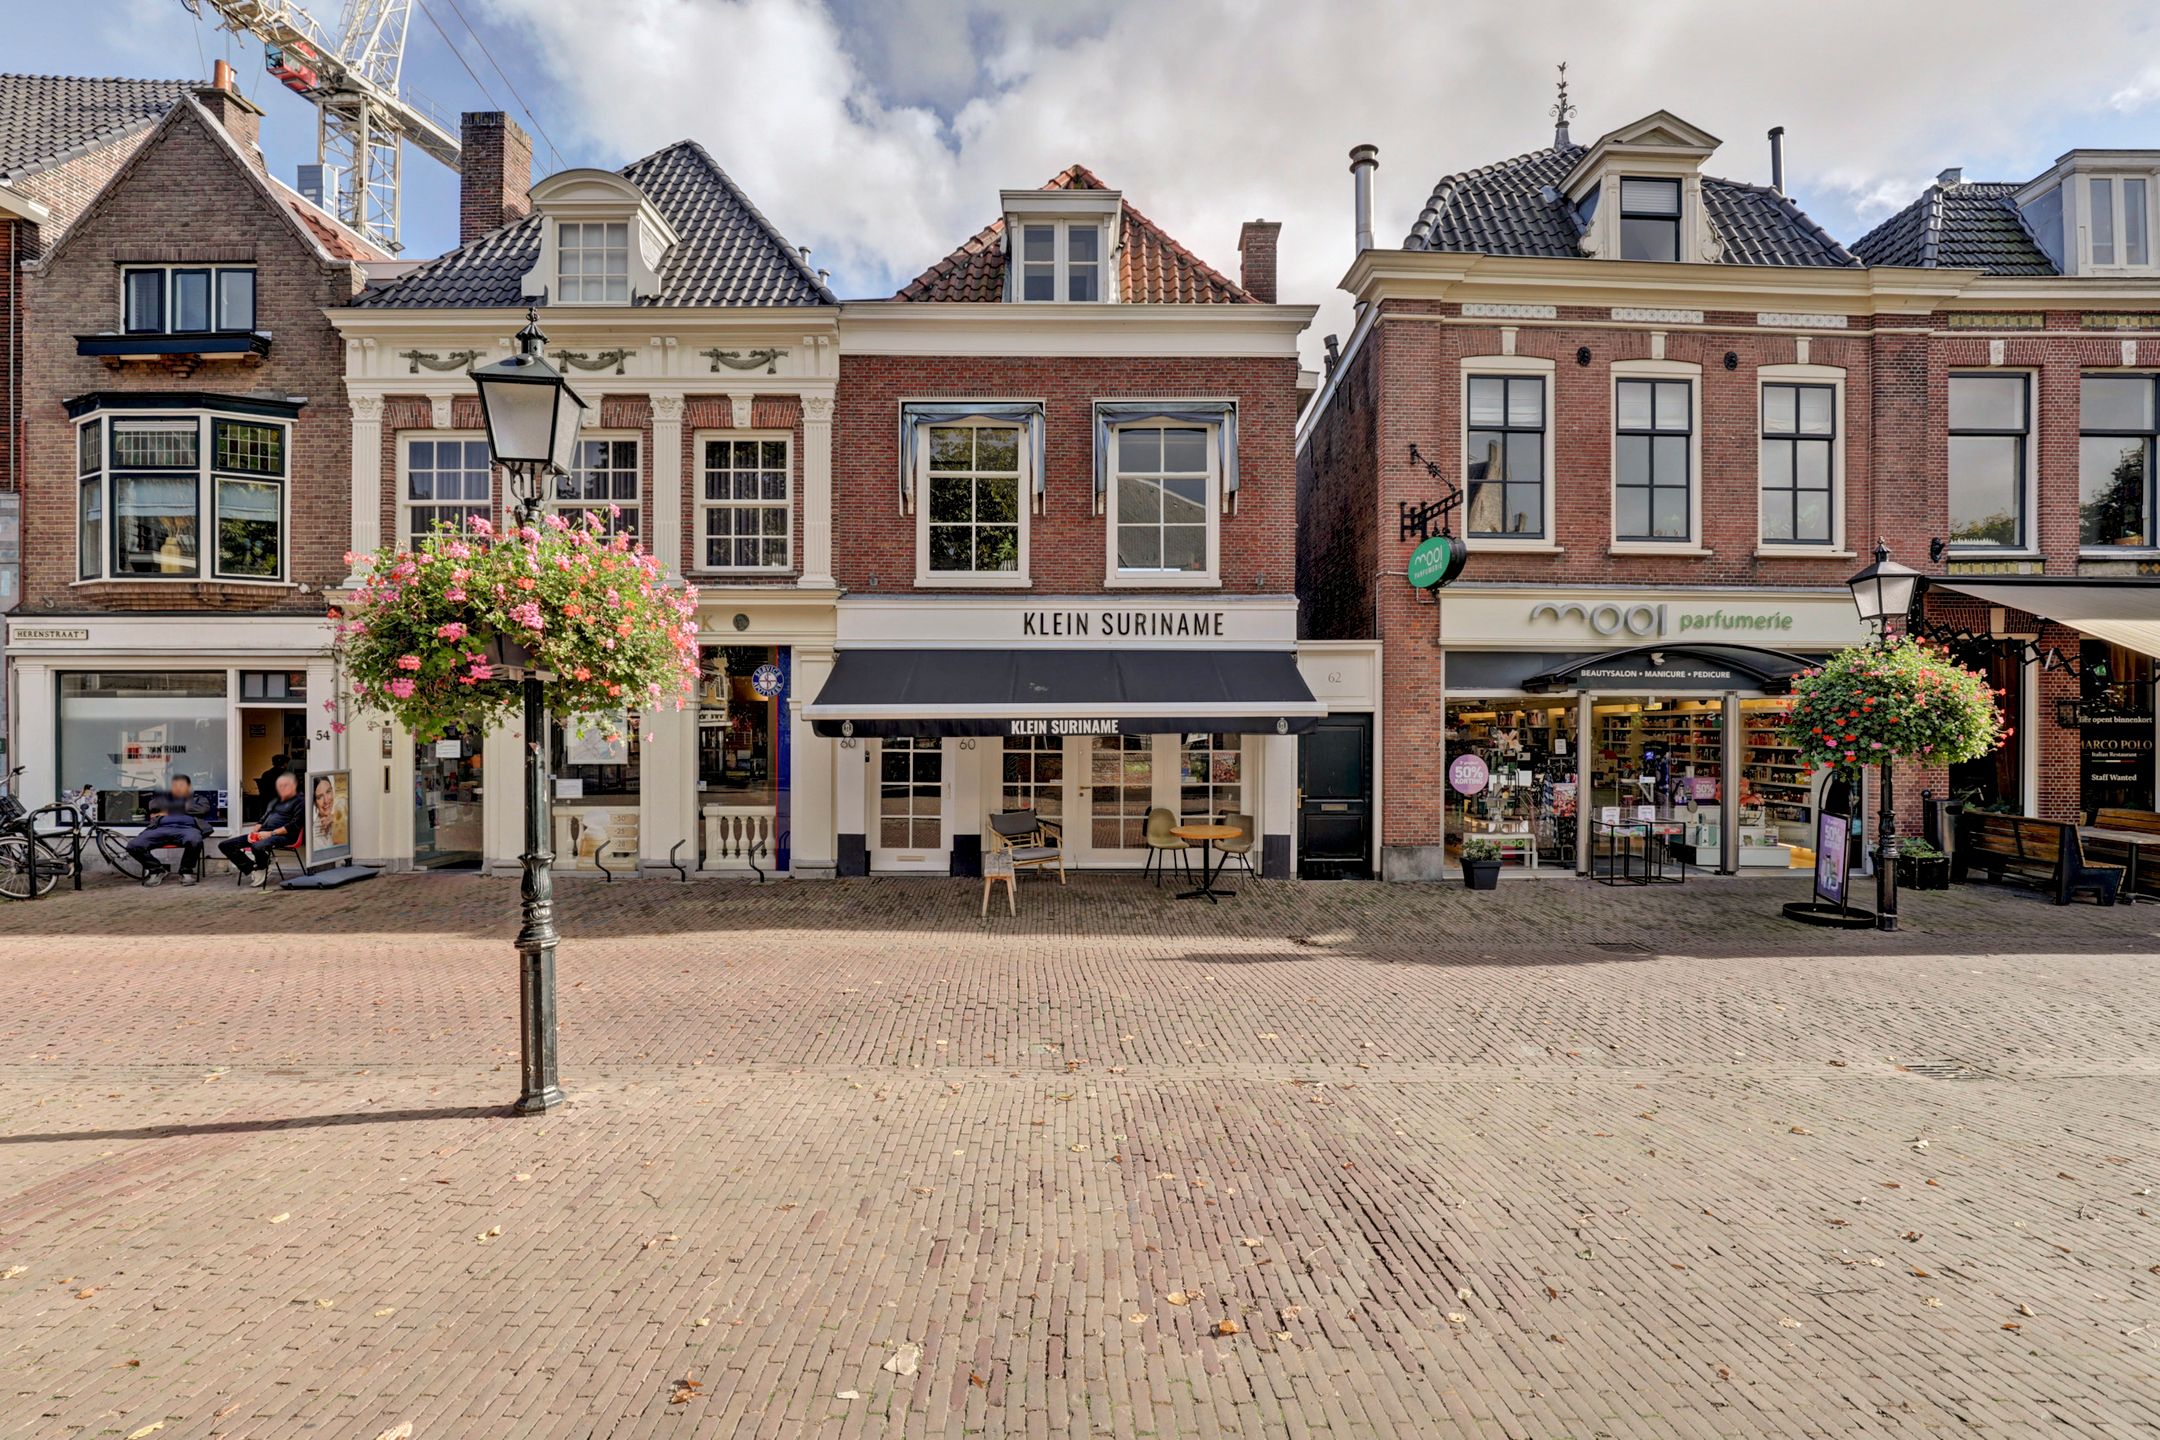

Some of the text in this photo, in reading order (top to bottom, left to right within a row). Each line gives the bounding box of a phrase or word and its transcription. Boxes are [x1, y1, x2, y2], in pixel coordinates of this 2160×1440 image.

[1023, 612, 1224, 636] KLEIN SURINAME
[1679, 609, 1794, 632] parfumerie
[17, 630, 79, 638] HERENSTRAAT
[1328, 671, 1342, 684] 62
[1581, 669, 1731, 679] BEAUTYSALON MANICURE PEDICURE
[2092, 716, 2113, 725] opent
[2113, 715, 2153, 724] binnenkort
[1011, 719, 1119, 735] KLEIN SURINAME
[315, 730, 330, 741] 54
[840, 737, 857, 749] 60
[959, 738, 976, 751] 60
[2121, 740, 2153, 750] POLO
[1455, 766, 1484, 779] 50%
[2091, 773, 2137, 781] Staff Wanted
